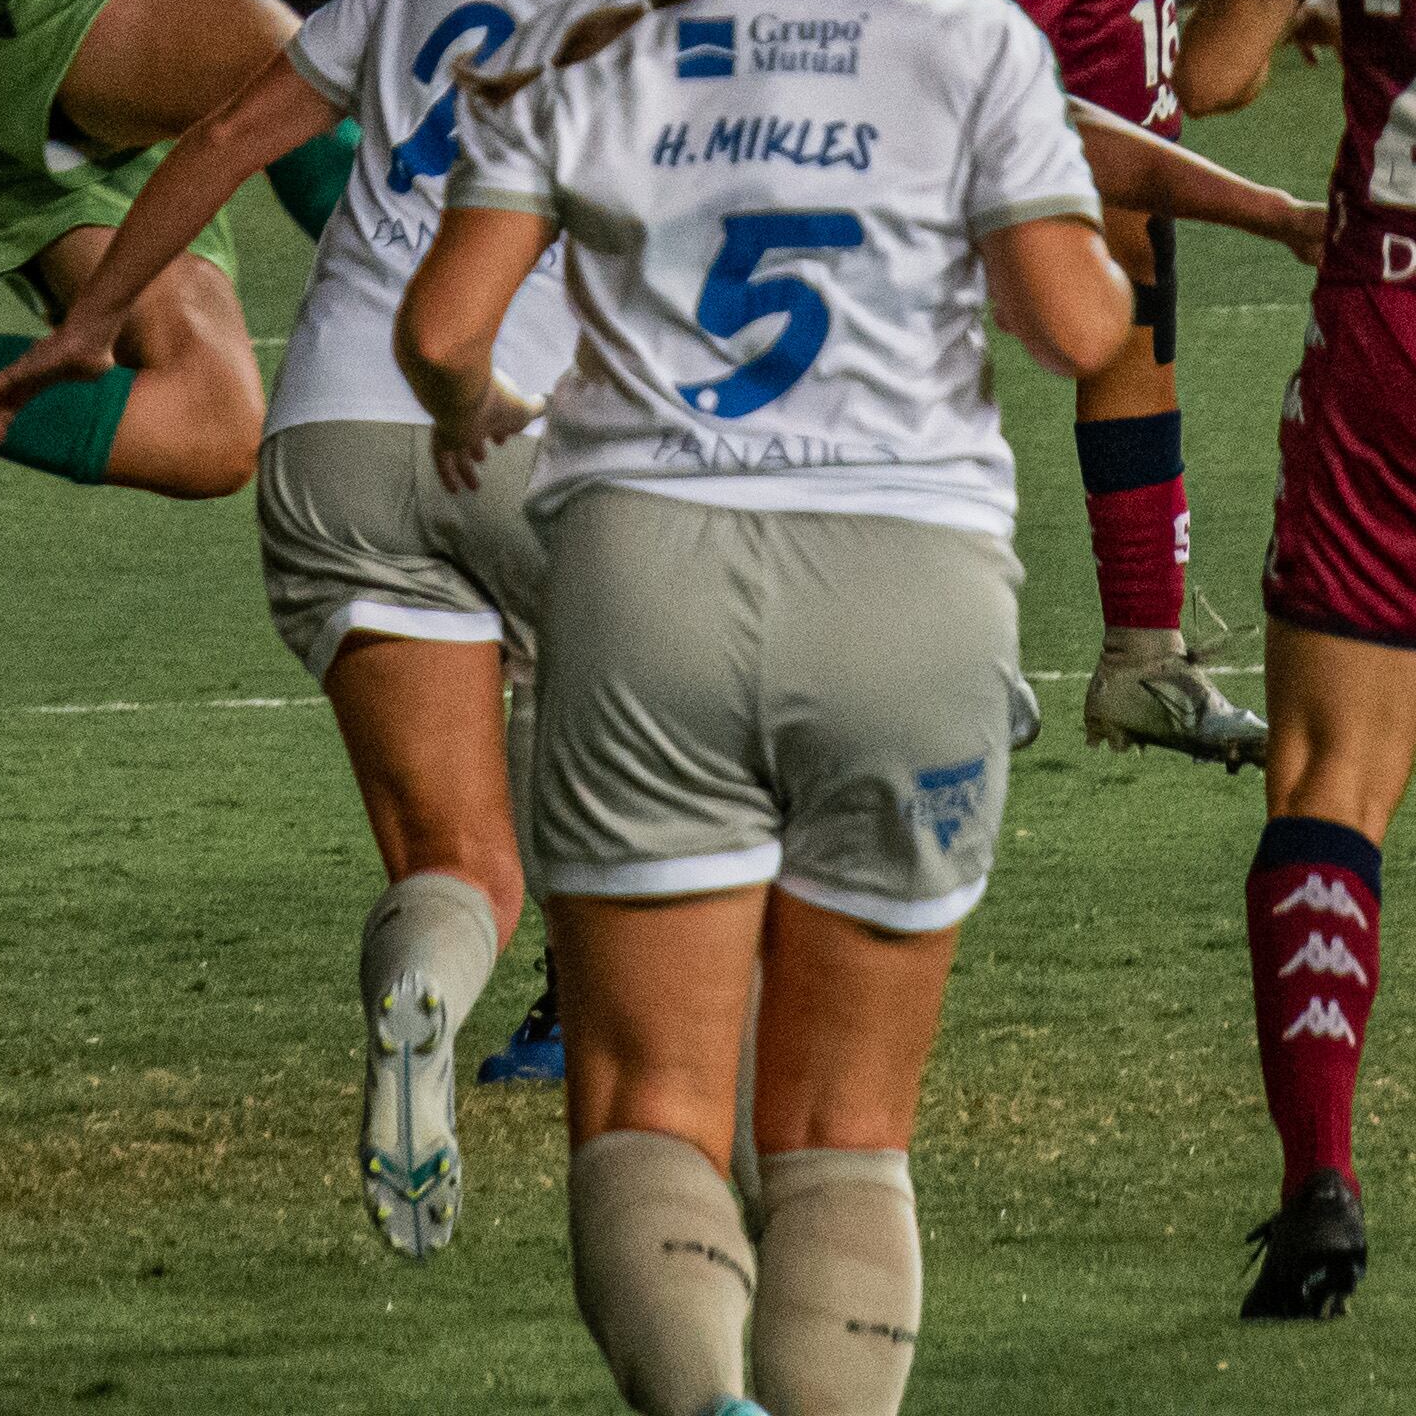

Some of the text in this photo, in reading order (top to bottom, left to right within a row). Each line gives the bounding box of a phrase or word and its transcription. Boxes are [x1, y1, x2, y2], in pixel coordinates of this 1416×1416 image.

[747, 12, 863, 49] Grupo
[750, 45, 860, 75] Mutual
[652, 115, 879, 171] H.MIKLES
[674, 211, 865, 419] 5
